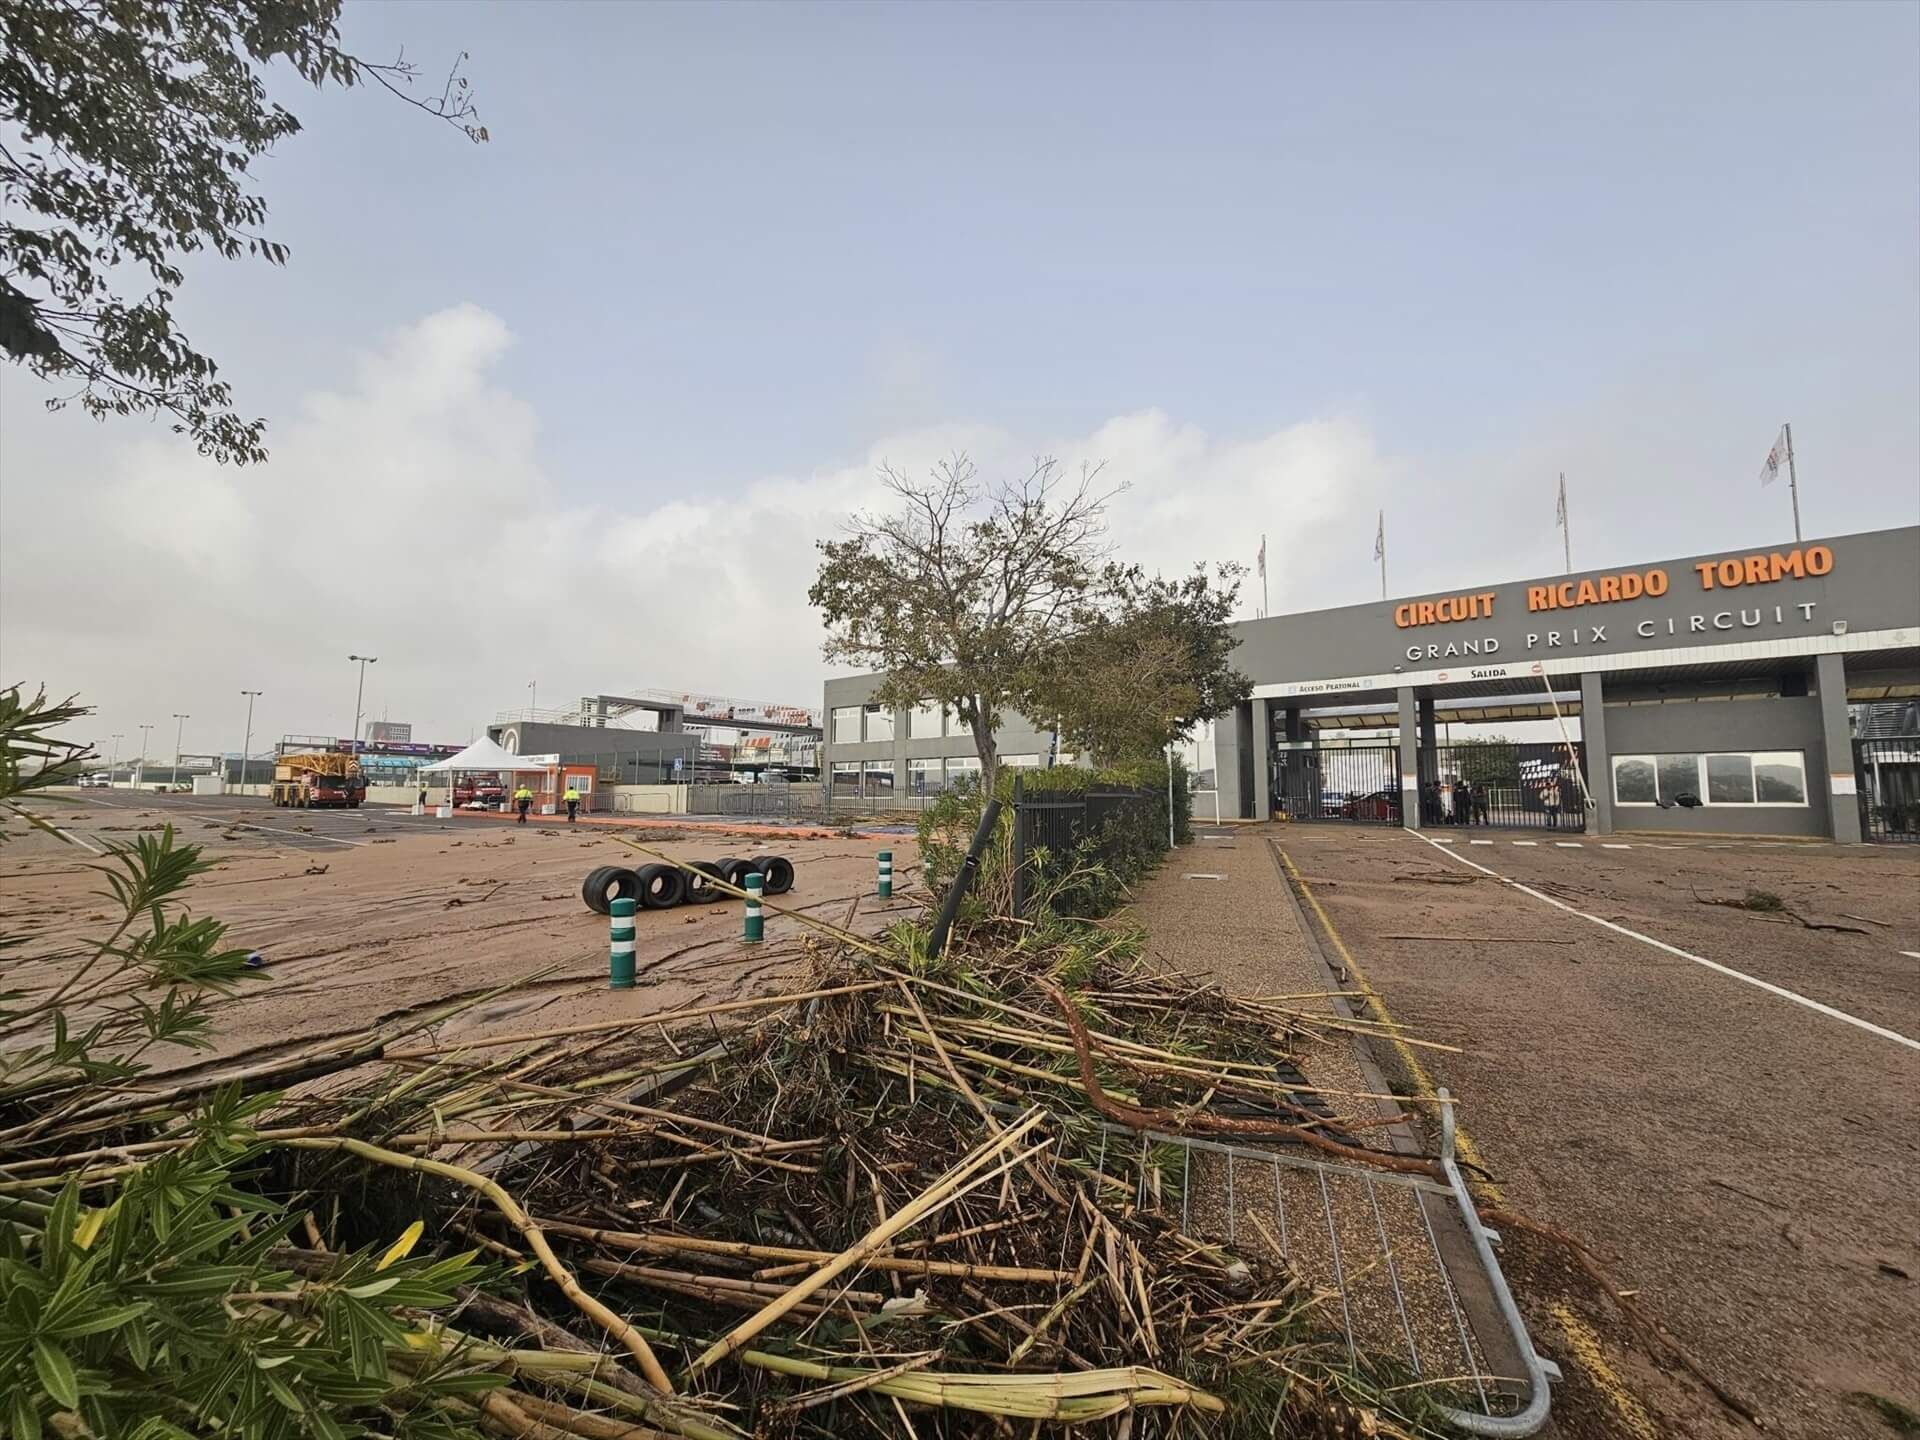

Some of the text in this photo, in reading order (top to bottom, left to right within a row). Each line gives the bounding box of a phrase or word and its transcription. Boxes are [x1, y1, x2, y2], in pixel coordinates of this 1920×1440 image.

[1395, 544, 1834, 629] CIRCUIT RICARDO TORMO
[1406, 602, 1816, 661] GRAND PRIX CIRCUIT
[1471, 668, 1507, 679] SALIDA
